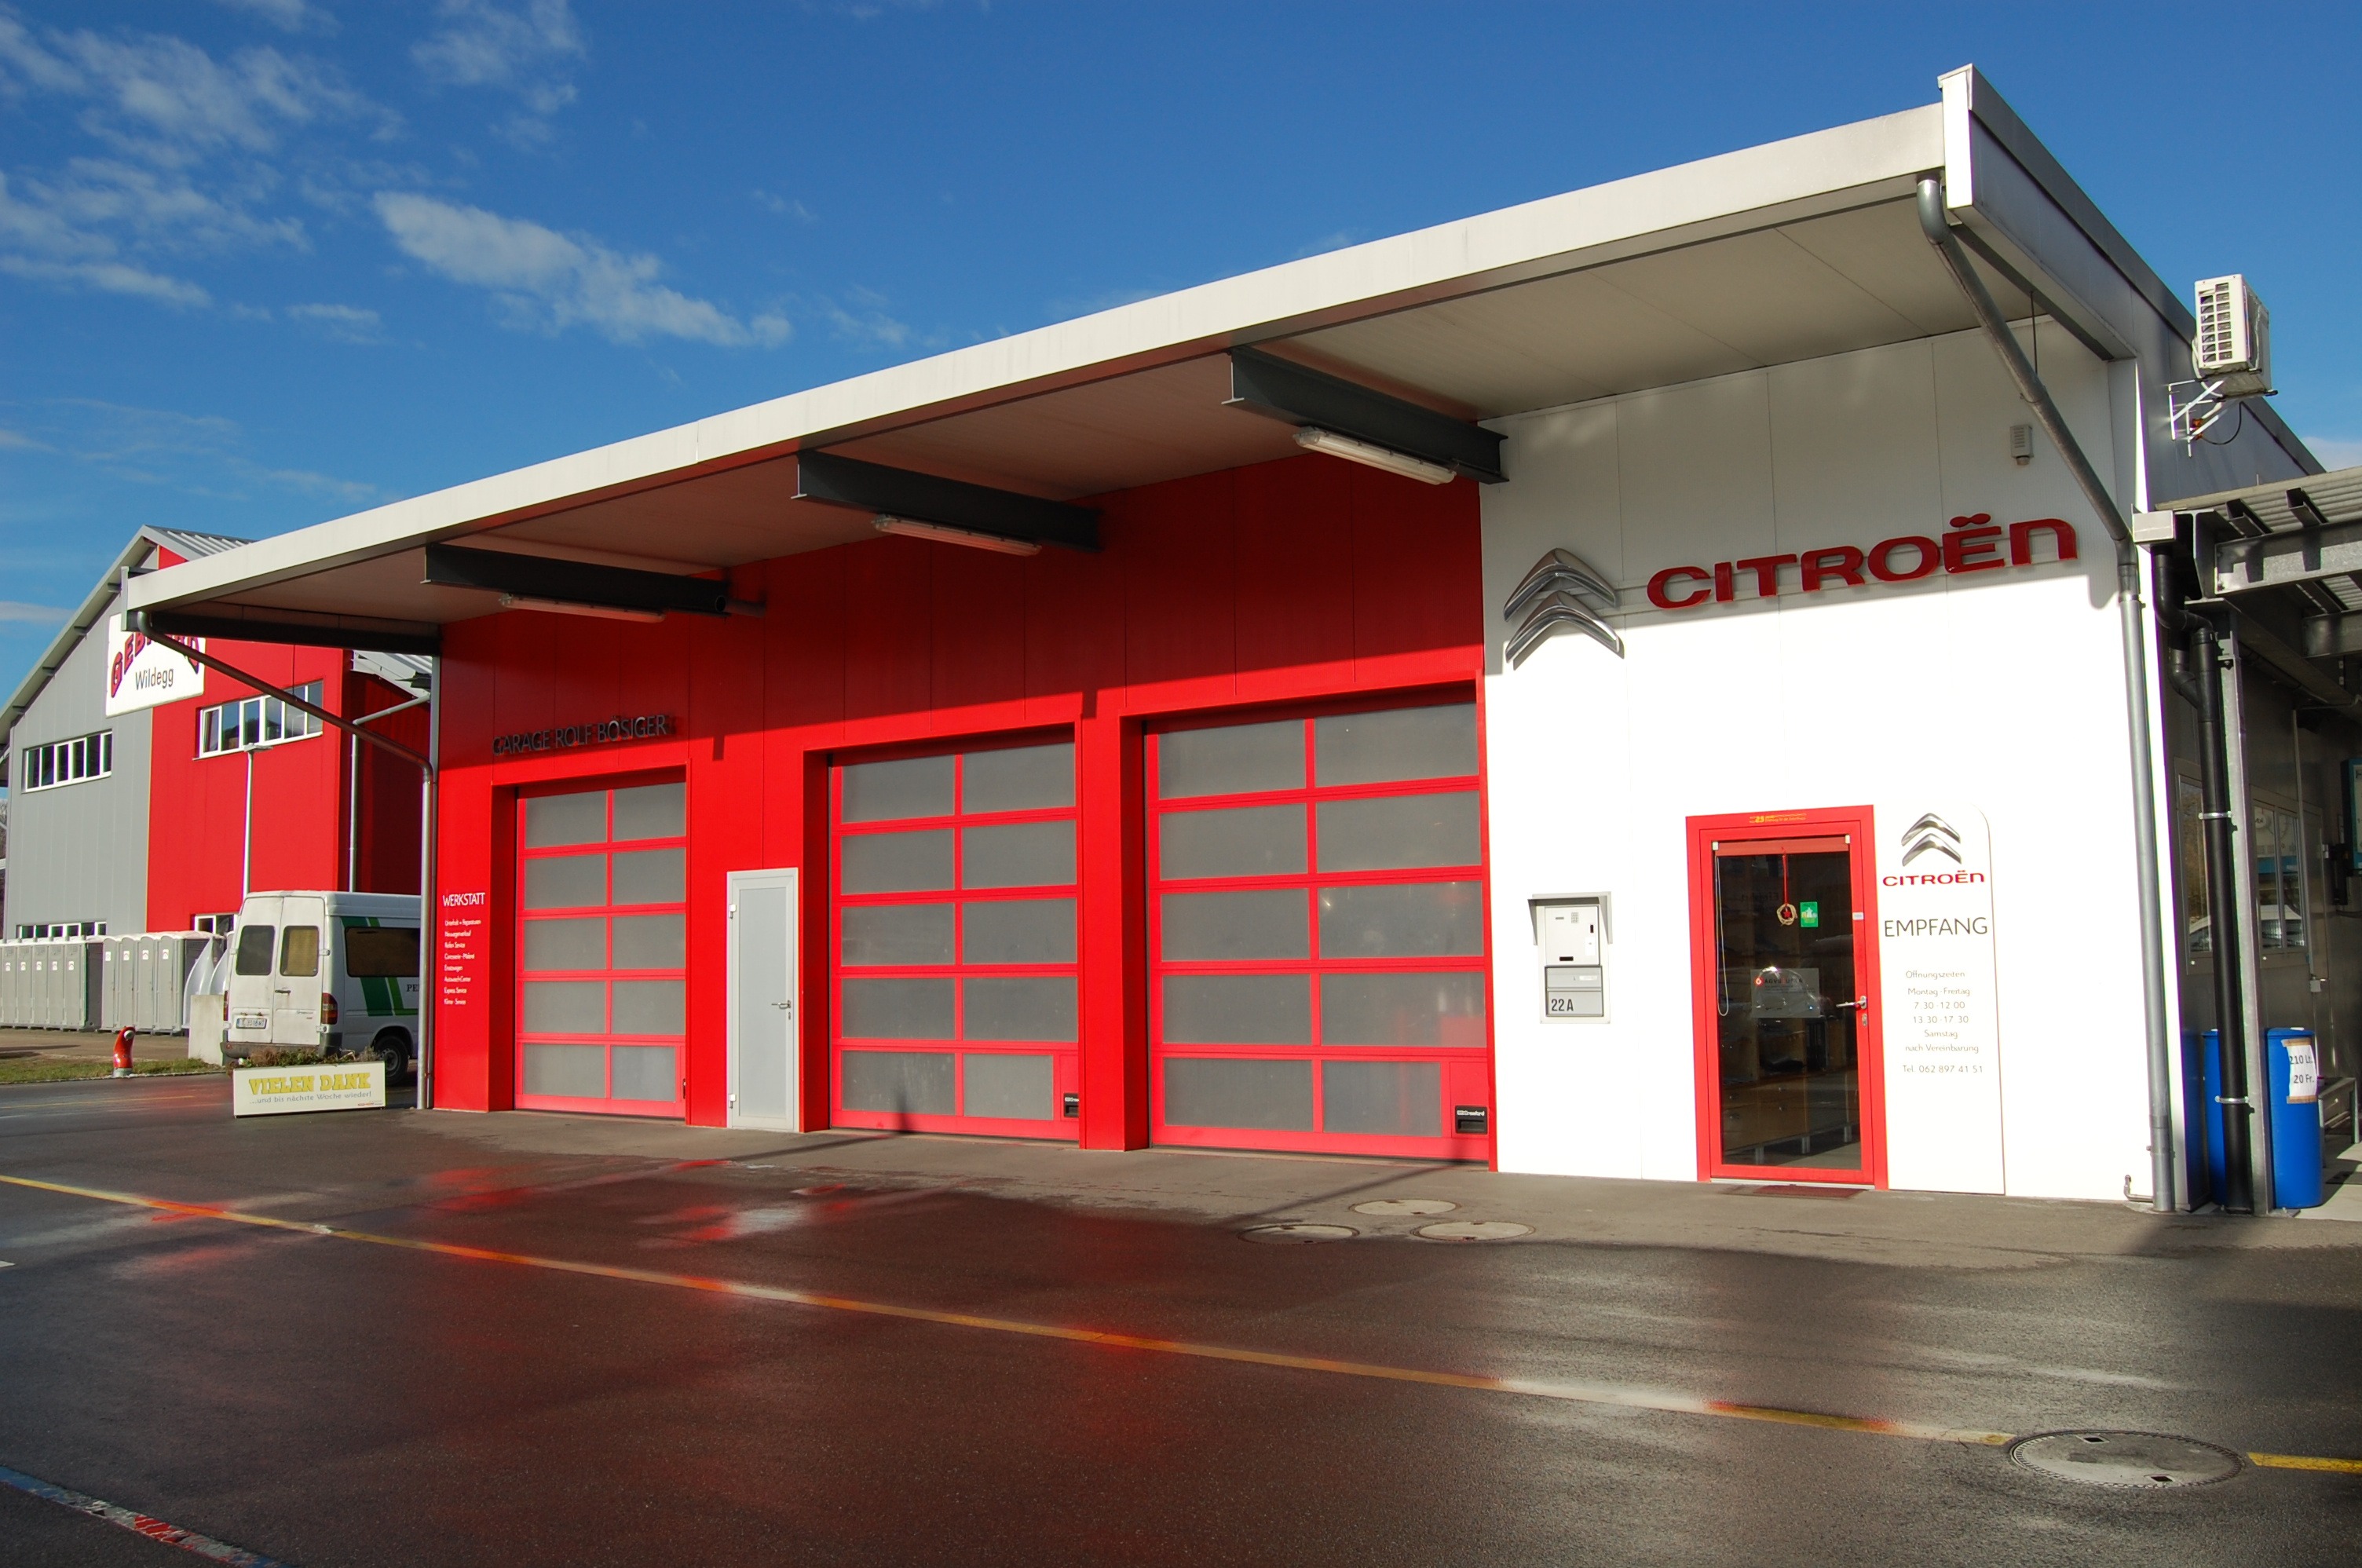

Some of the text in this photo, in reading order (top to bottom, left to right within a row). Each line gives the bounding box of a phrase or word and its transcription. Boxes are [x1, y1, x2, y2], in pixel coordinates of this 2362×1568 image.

[135, 667, 174, 690] Wildegg
[492, 714, 667, 756] GARAGE ROLF BÖSIGER
[442, 891, 485, 907] WERKSTATT
[1884, 916, 1988, 938] EMPFANG
[1907, 987, 1939, 997] Montag
[1943, 986, 1970, 997] Freitag
[1924, 1029, 1958, 1040] Samstag
[1925, 1044, 1980, 1054] Vereinbarung
[1918, 1065, 1936, 1073] 062
[1938, 1065, 1955, 1073] 897
[248, 1072, 371, 1095] VIELEN DANK
[2294, 1074, 2304, 1084] 20
[274, 1095, 284, 1103] bis
[287, 1094, 314, 1102] nächste
